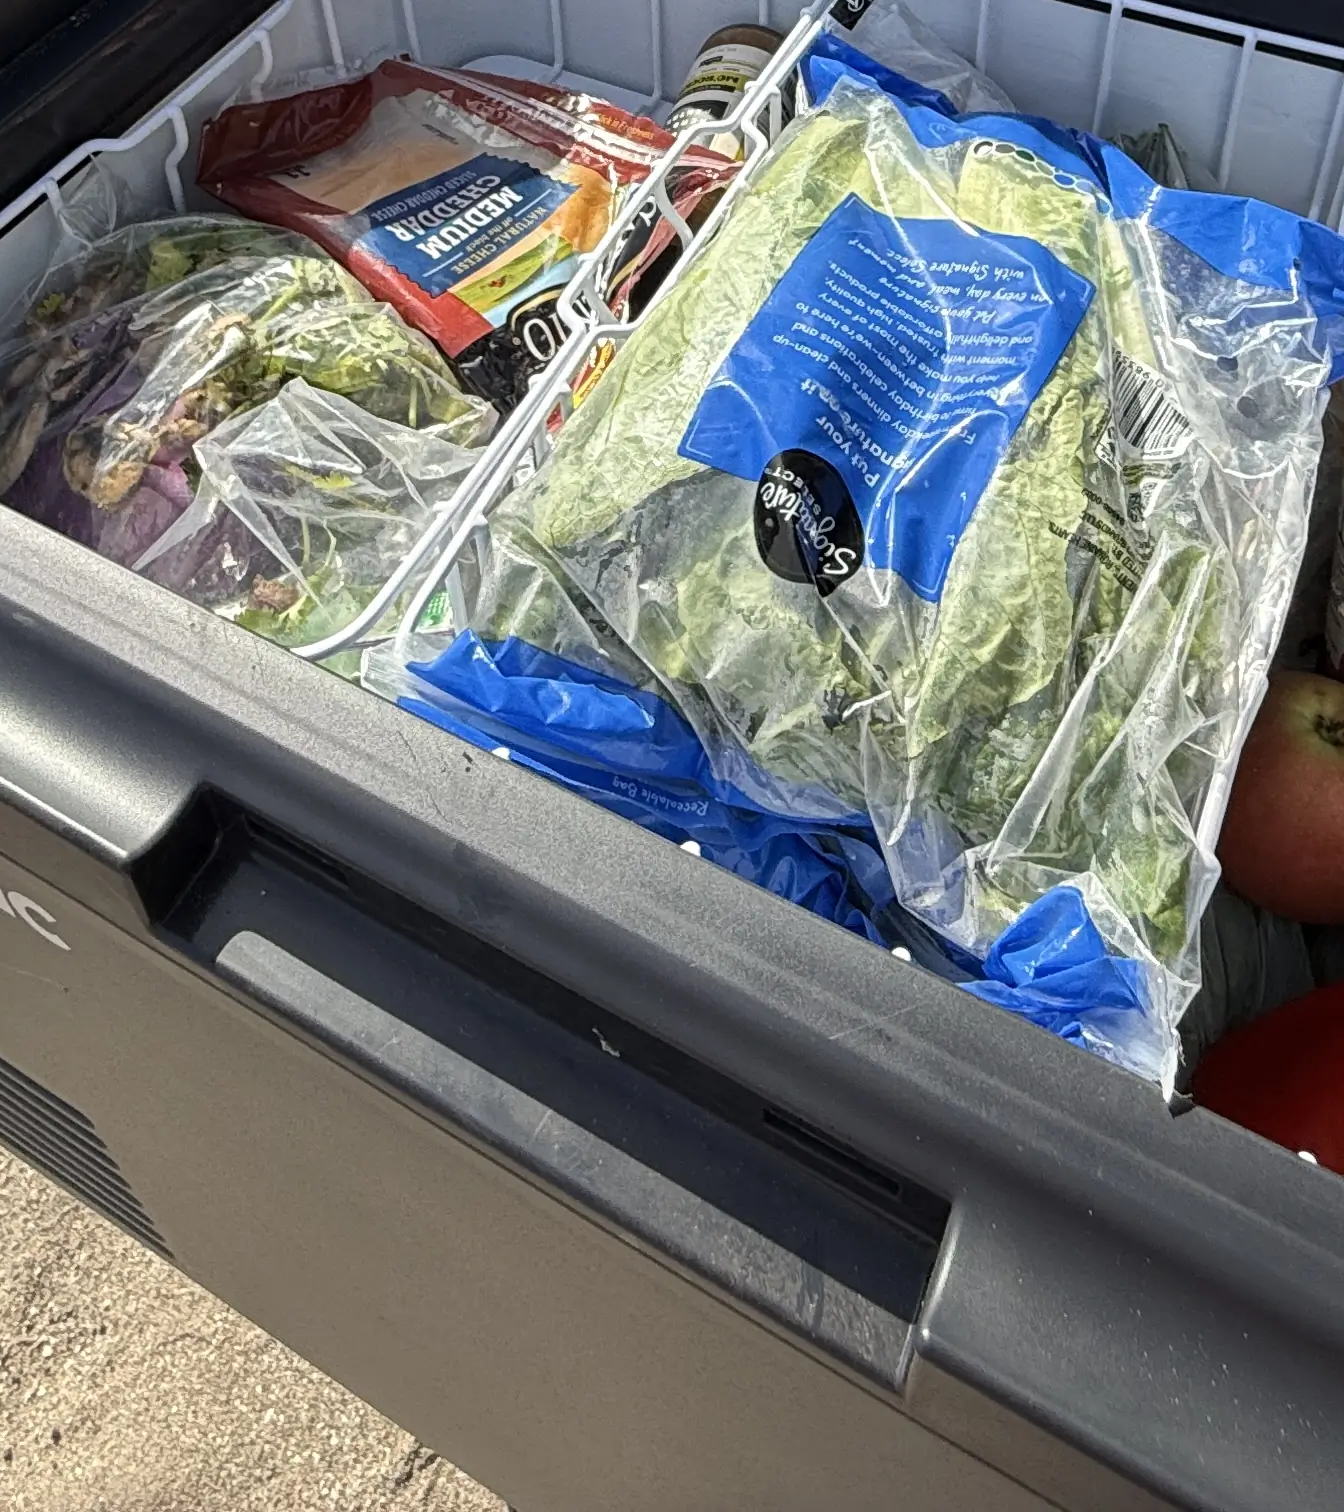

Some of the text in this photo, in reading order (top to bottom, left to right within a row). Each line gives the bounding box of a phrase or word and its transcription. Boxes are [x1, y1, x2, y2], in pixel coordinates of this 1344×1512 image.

[383, 175, 501, 239] CHEDDAR
[415, 185, 523, 261] MEDIUM
[450, 206, 547, 274] NATURAL CHEESE
[928, 259, 988, 280] Signature
[795, 301, 808, 313] to
[810, 306, 840, 328] here
[817, 292, 851, 314] every
[790, 321, 818, 335] and
[867, 322, 899, 348] most
[818, 331, 887, 391] celebrations
[898, 344, 916, 364] the
[772, 333, 891, 420] dinners and clean-up
[814, 413, 881, 487] Put your
[758, 480, 858, 574] Signature
